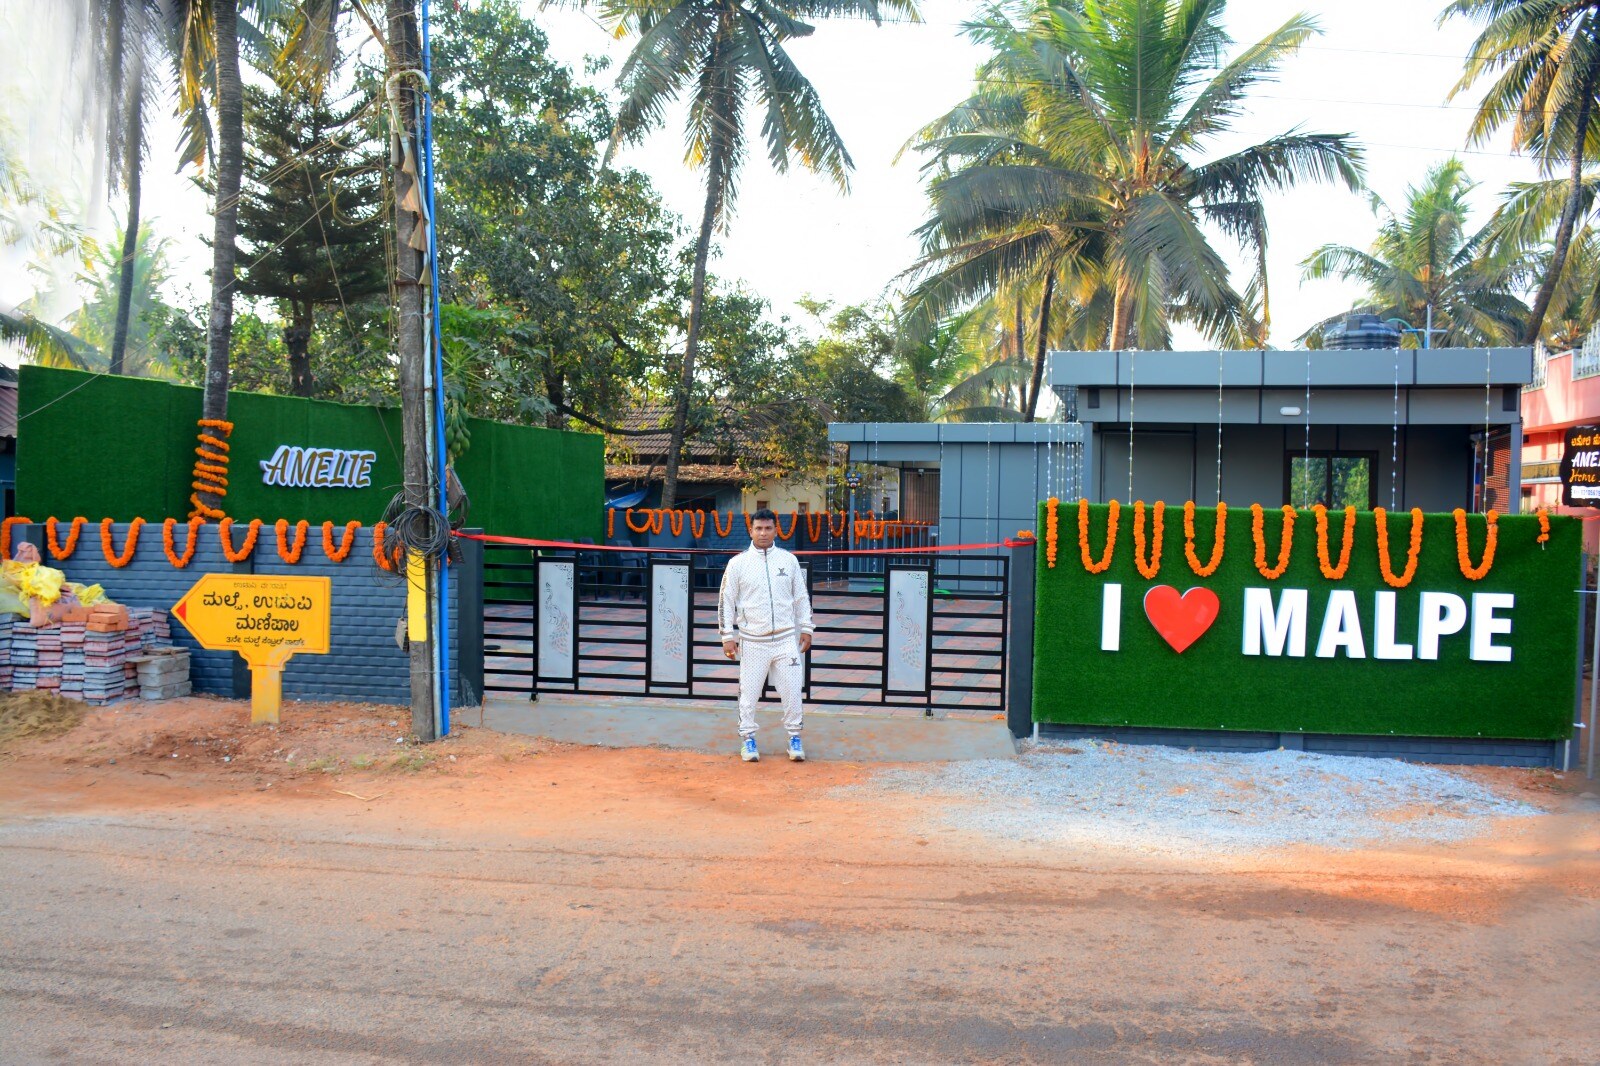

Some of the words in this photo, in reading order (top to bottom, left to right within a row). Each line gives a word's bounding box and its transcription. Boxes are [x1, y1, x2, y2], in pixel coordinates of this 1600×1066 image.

[260, 445, 376, 488] AMELIE
[1569, 468, 1596, 483] Home
[236, 612, 299, 631] ಮಣಿಪಾಲ
[1101, 583, 1122, 651] I
[1242, 587, 1515, 662] MALPE
